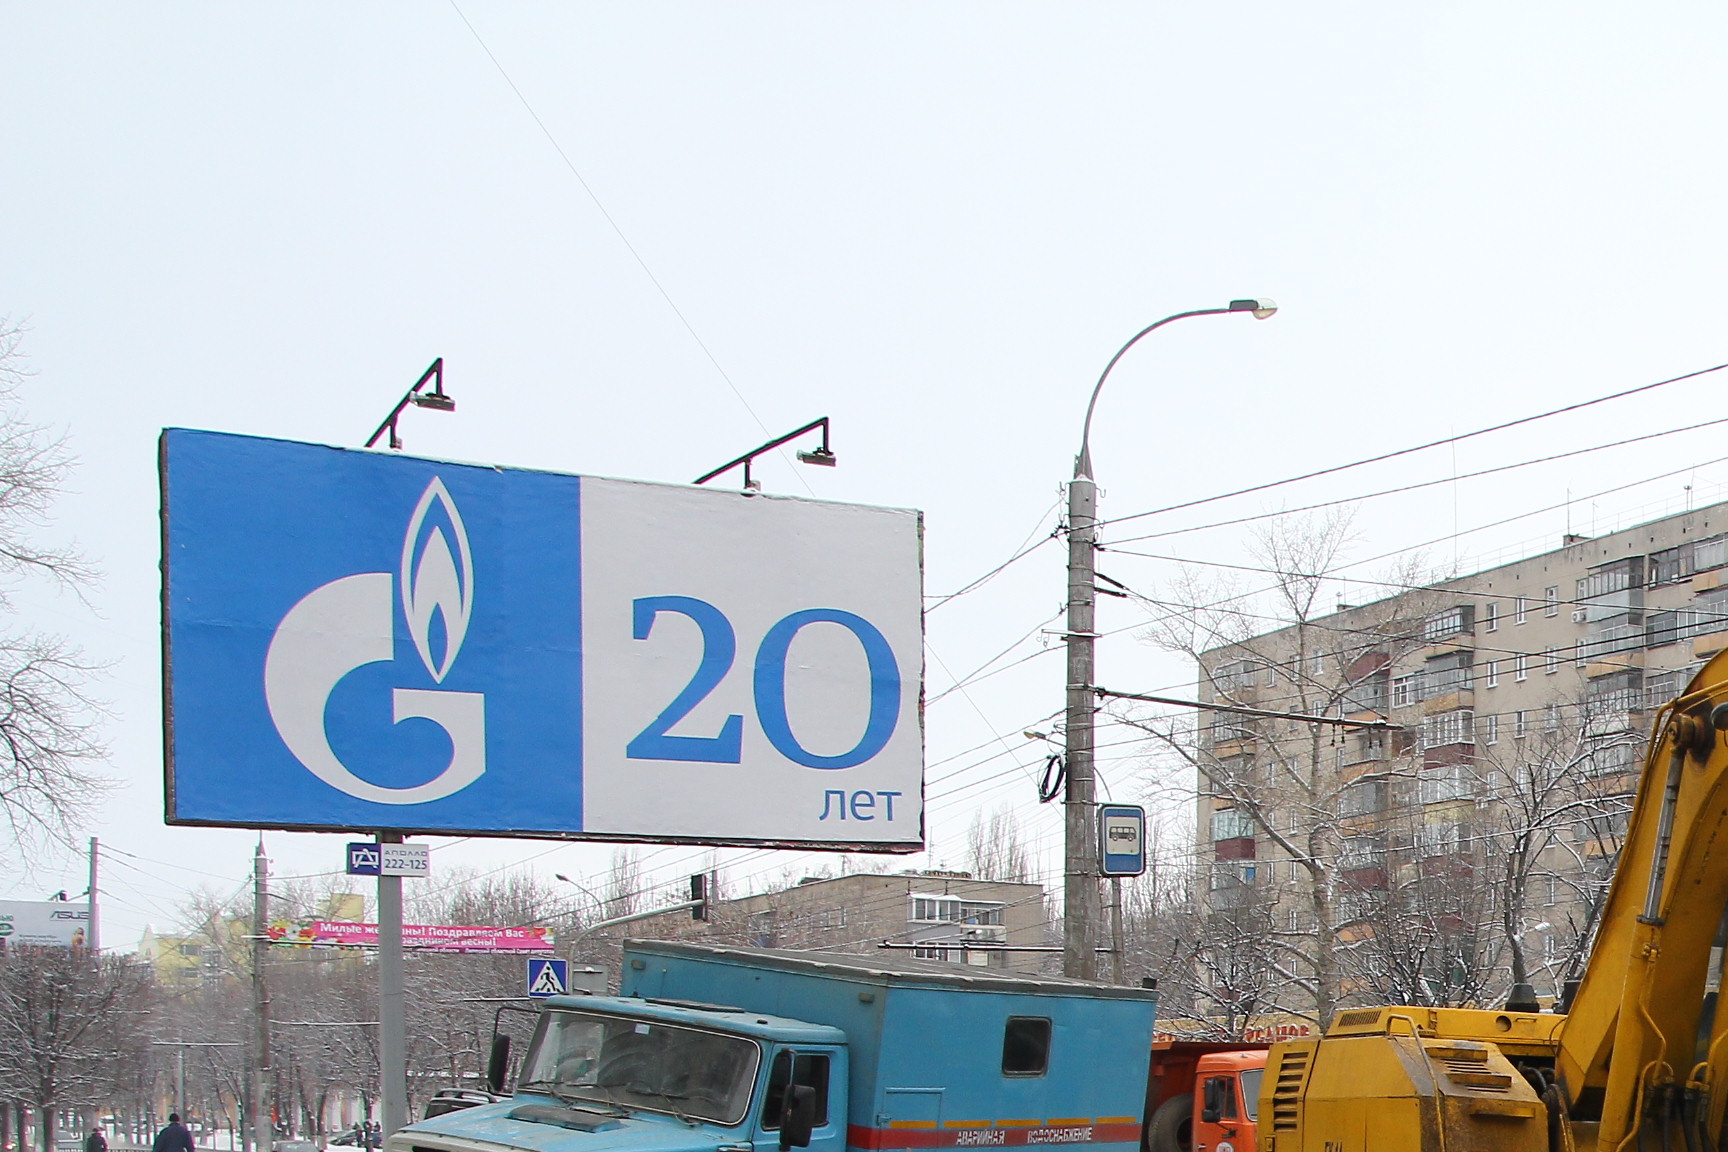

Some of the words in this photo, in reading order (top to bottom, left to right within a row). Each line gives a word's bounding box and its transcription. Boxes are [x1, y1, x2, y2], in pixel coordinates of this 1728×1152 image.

[626, 595, 901, 770] 20
[819, 788, 903, 822] лет
[385, 859, 427, 870] 222-125
[320, 923, 362, 934] Милые
[428, 927, 503, 939] Поздравляем
[505, 929, 525, 938] Вас
[461, 937, 496, 947] весны!
[956, 1129, 1005, 1145] АВАРИЙНАЯ
[1027, 1127, 1092, 1144] ВОДОСНАБЖЕНИЕ
